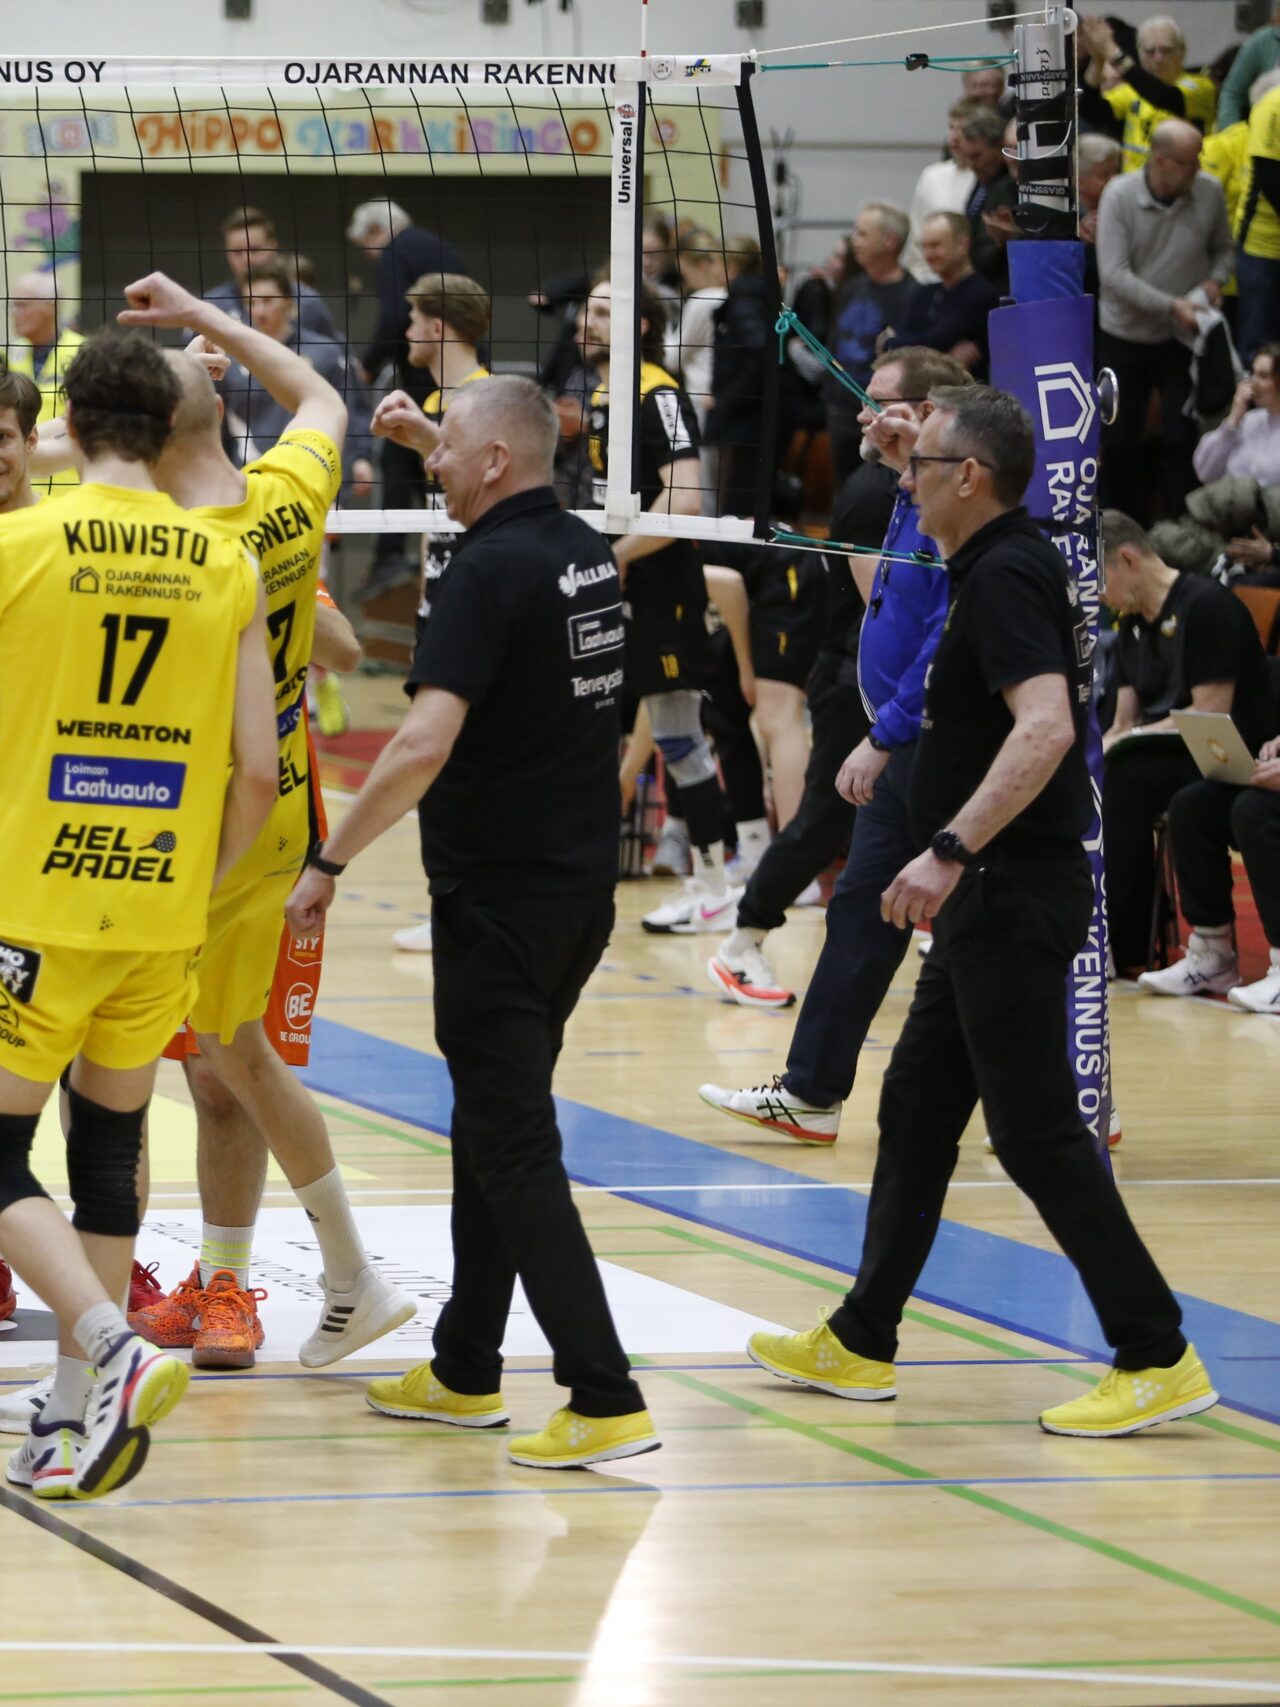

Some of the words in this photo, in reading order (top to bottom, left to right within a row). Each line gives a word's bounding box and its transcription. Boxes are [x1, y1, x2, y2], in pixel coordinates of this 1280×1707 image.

[63, 61, 106, 84] OY
[284, 62, 469, 85] OJARANNAN
[618, 120, 633, 205] Universal
[63, 519, 209, 567] KOIVISTO
[105, 569, 191, 587] OJARANNAN
[105, 583, 182, 601] RAKENNUS
[185, 590, 202, 601] OY
[97, 613, 170, 706] 17
[56, 719, 192, 745] WERRATON
[65, 761, 109, 775] Loimaan
[63, 773, 171, 802] Laatuauto
[53, 823, 133, 853] HEL
[41, 850, 176, 883] PADEL
[288, 992, 312, 1018] BE
